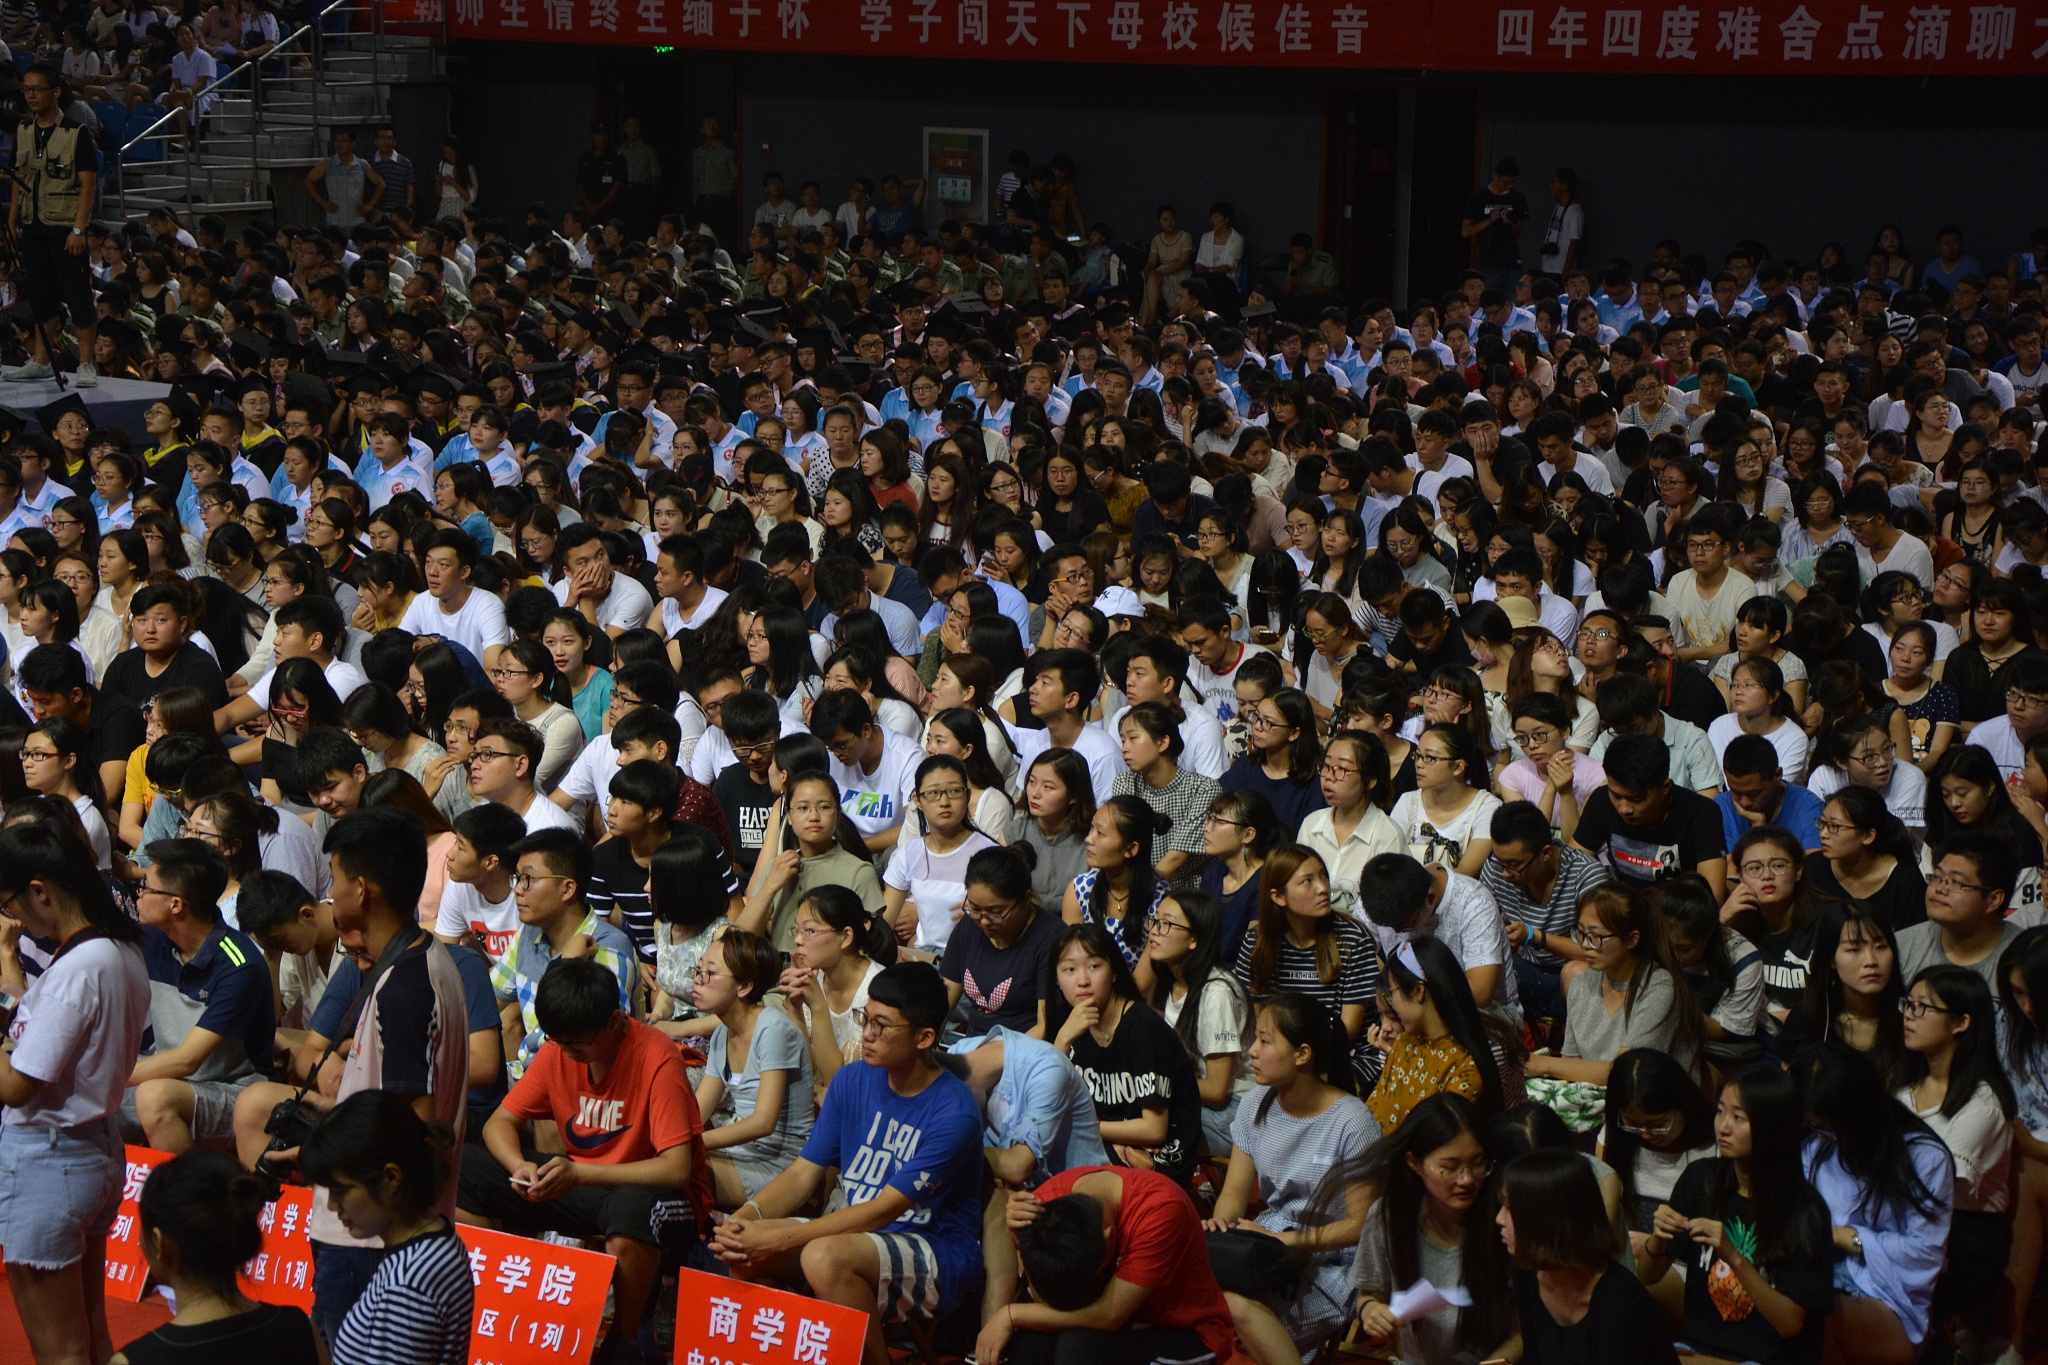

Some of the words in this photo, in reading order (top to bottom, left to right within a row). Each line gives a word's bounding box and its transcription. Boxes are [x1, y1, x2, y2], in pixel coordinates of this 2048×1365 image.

[859, 0, 1370, 54] 学子闯天下母校候佳音
[1763, 964, 1807, 989] UMA
[1214, 1030, 1237, 1042] white
[576, 1095, 625, 1132] NIKE
[844, 1144, 892, 1186] DO
[709, 1296, 831, 1365] 商学院
